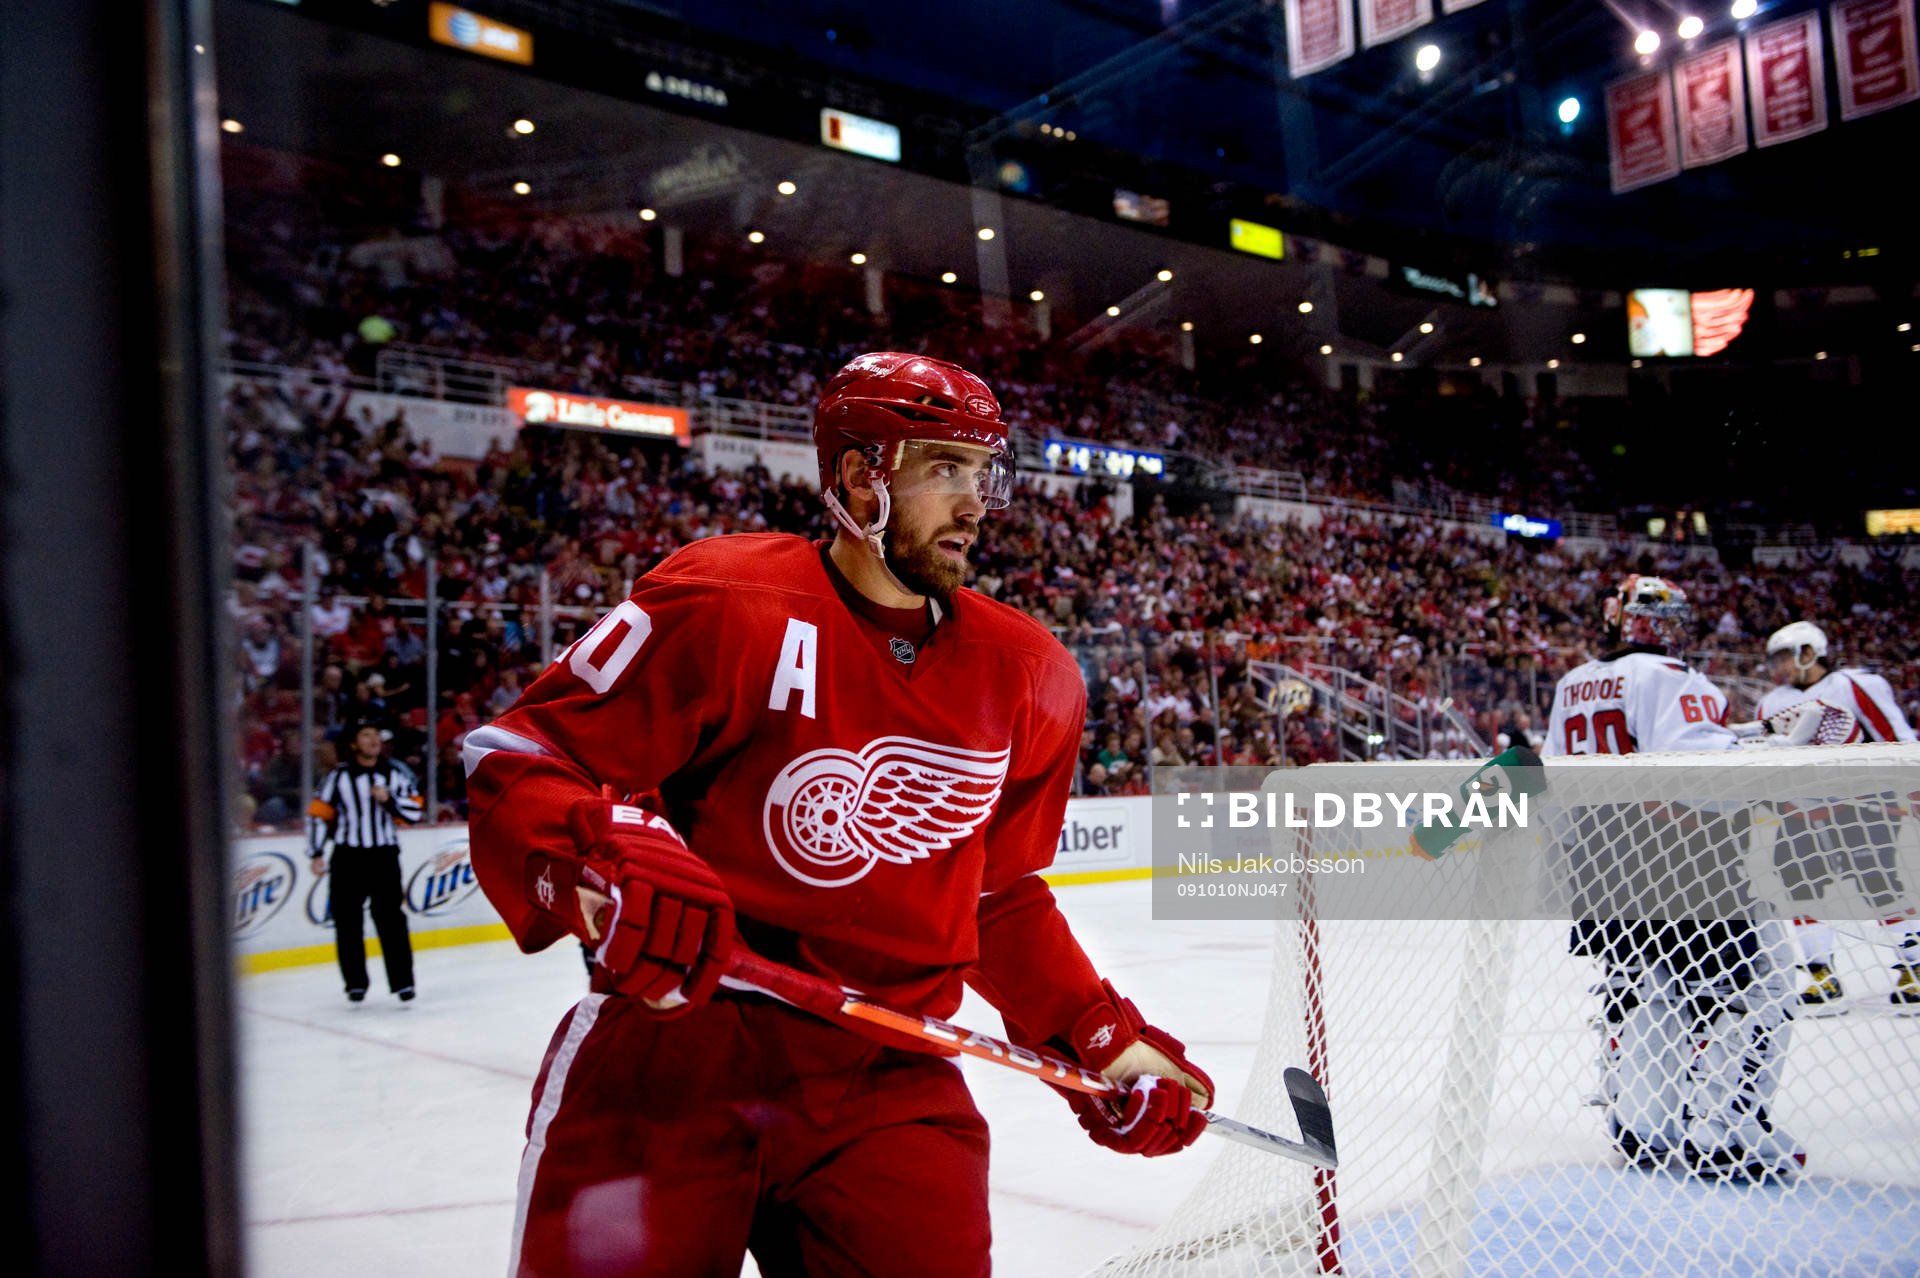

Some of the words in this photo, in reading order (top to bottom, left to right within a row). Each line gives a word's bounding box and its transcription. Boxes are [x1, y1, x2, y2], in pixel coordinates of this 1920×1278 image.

[554, 600, 653, 694] 0
[768, 617, 818, 719] A
[1680, 694, 1720, 725] 60
